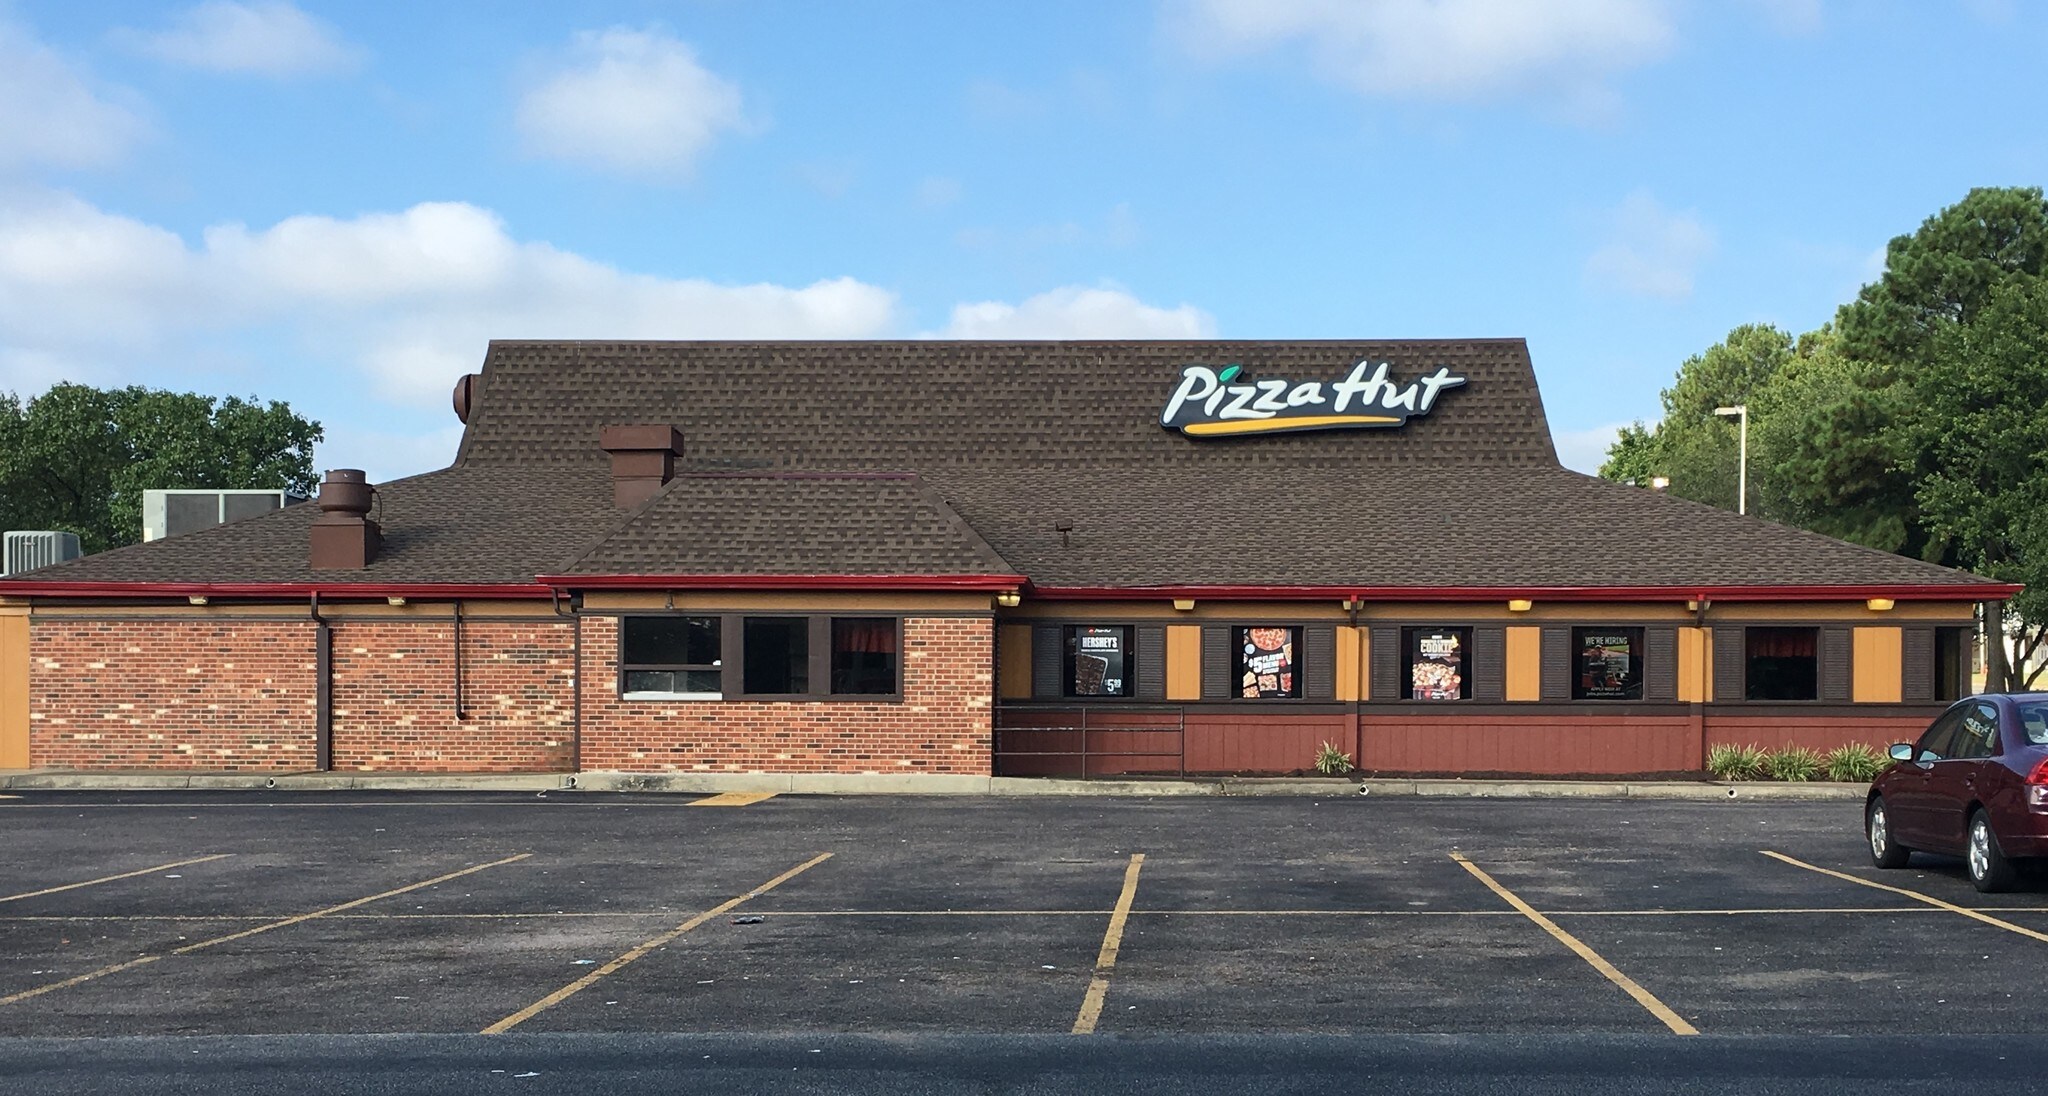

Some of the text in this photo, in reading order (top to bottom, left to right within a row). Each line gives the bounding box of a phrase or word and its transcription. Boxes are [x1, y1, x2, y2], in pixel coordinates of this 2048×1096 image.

[1163, 360, 1466, 424] Pizza Hut
[1082, 636, 1118, 649] HERSHEY'S
[1604, 636, 1628, 645] HIRING
